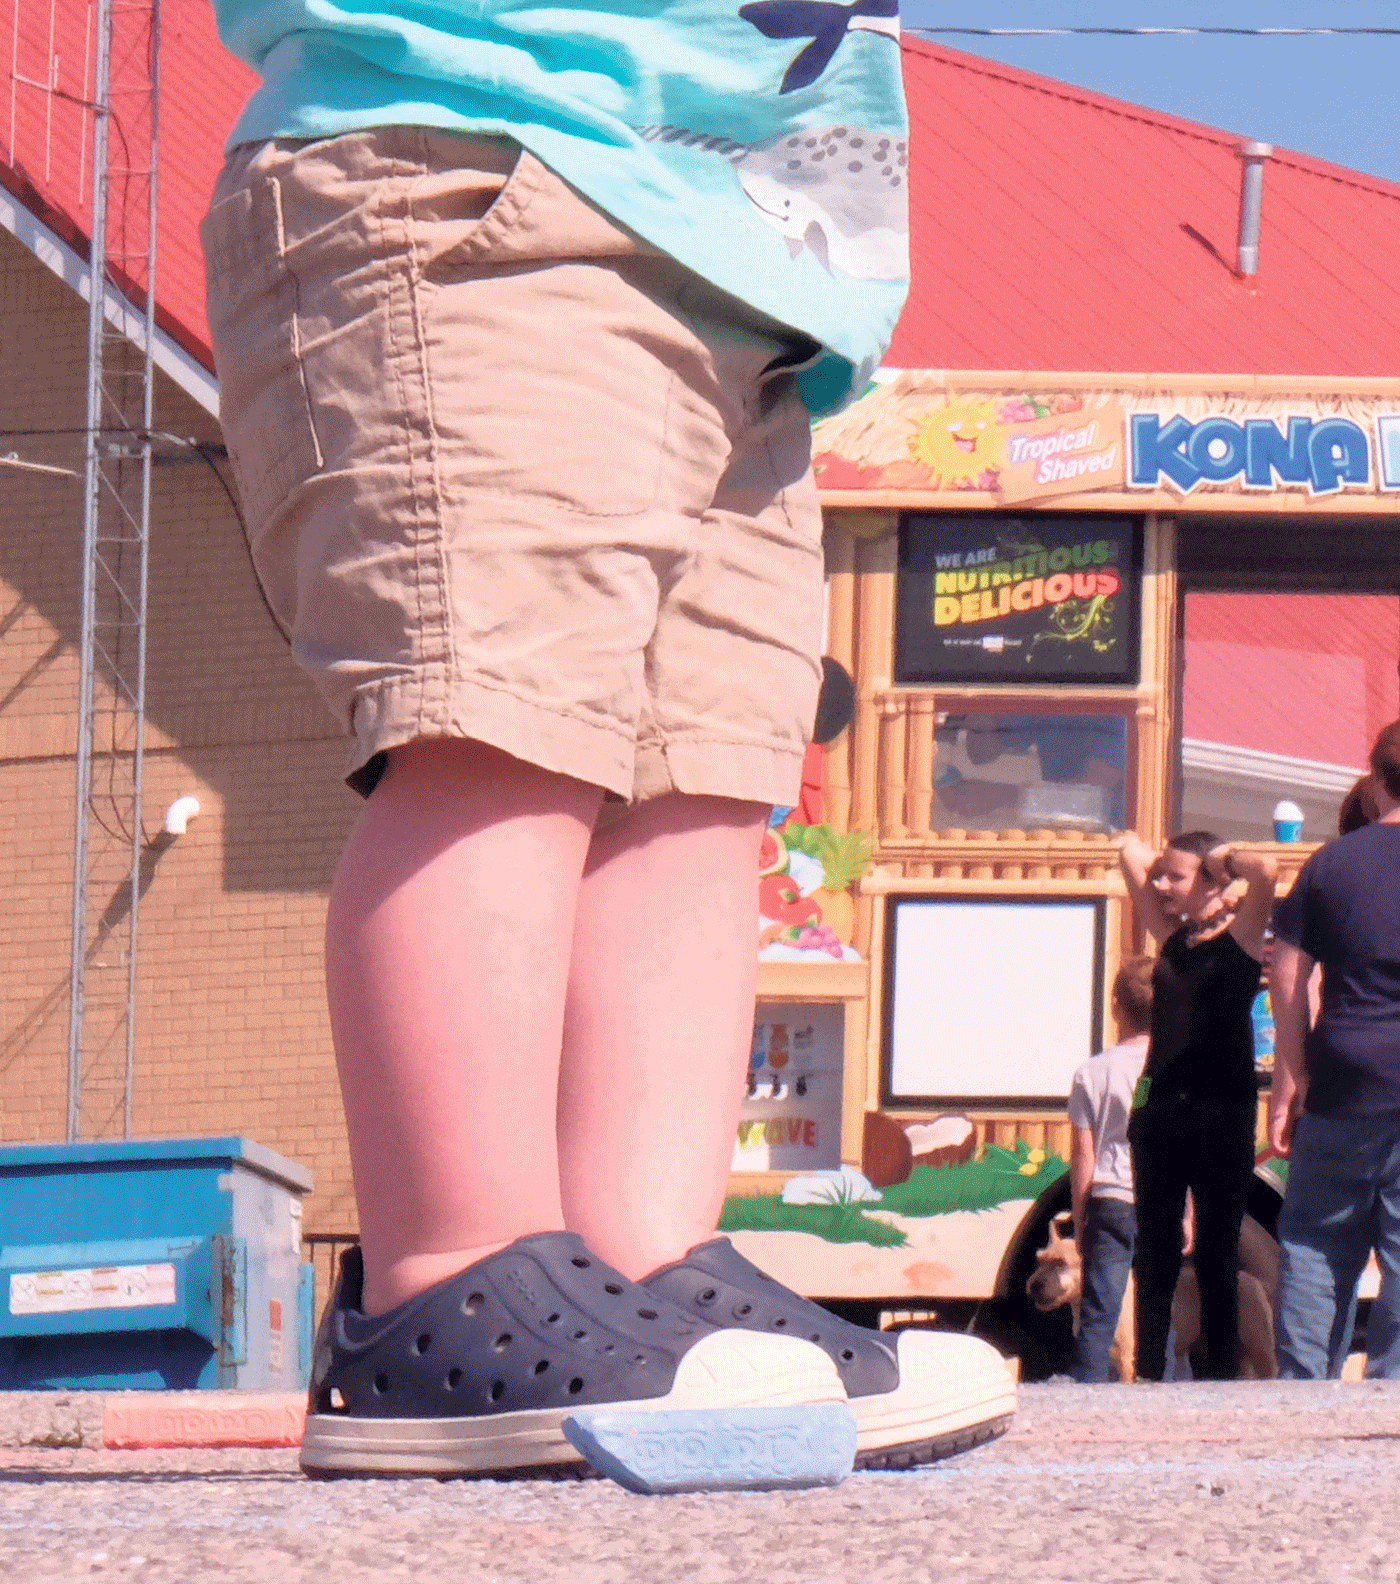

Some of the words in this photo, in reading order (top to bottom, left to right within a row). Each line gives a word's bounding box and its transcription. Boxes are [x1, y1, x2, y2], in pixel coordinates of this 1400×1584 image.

[1011, 422, 1097, 461] Tropical
[1131, 412, 1371, 492] KONA
[1037, 446, 1116, 484] Shaved
[935, 553, 962, 569] WE
[964, 546, 997, 567] ARE
[935, 540, 1110, 594] NUTRITIOUS
[934, 567, 1121, 626] DELICIOUS
